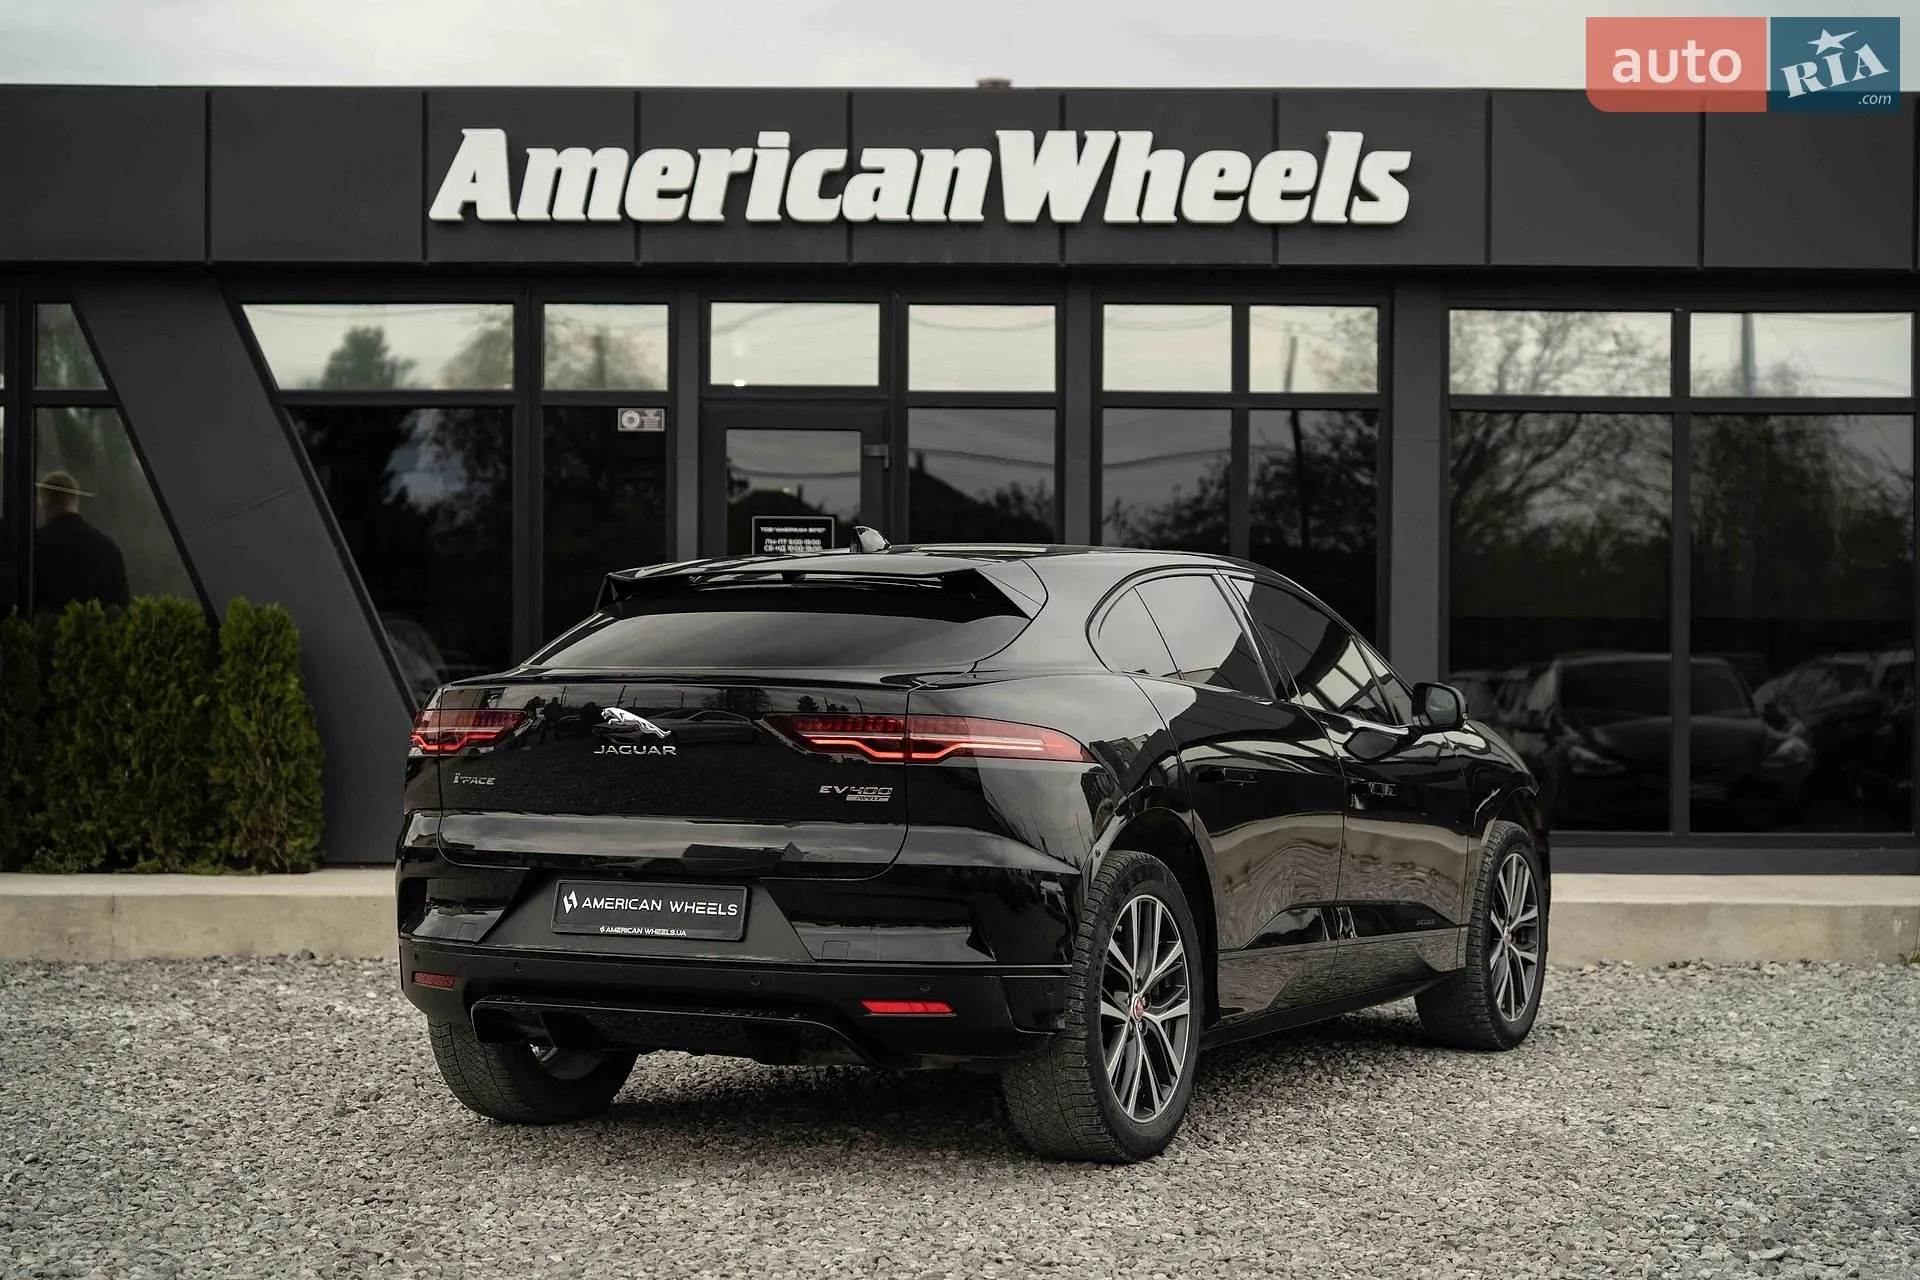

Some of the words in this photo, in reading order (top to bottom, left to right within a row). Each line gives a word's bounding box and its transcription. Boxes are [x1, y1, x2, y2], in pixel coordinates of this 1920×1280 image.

[593, 745, 677, 755] JAGUAR
[819, 785, 893, 795] EV400
[581, 897, 662, 912] AMERICAN
[669, 900, 738, 916] WHEELS
[605, 926, 643, 935] AMERICAN
[644, 927, 687, 937] WHEELS.UA
